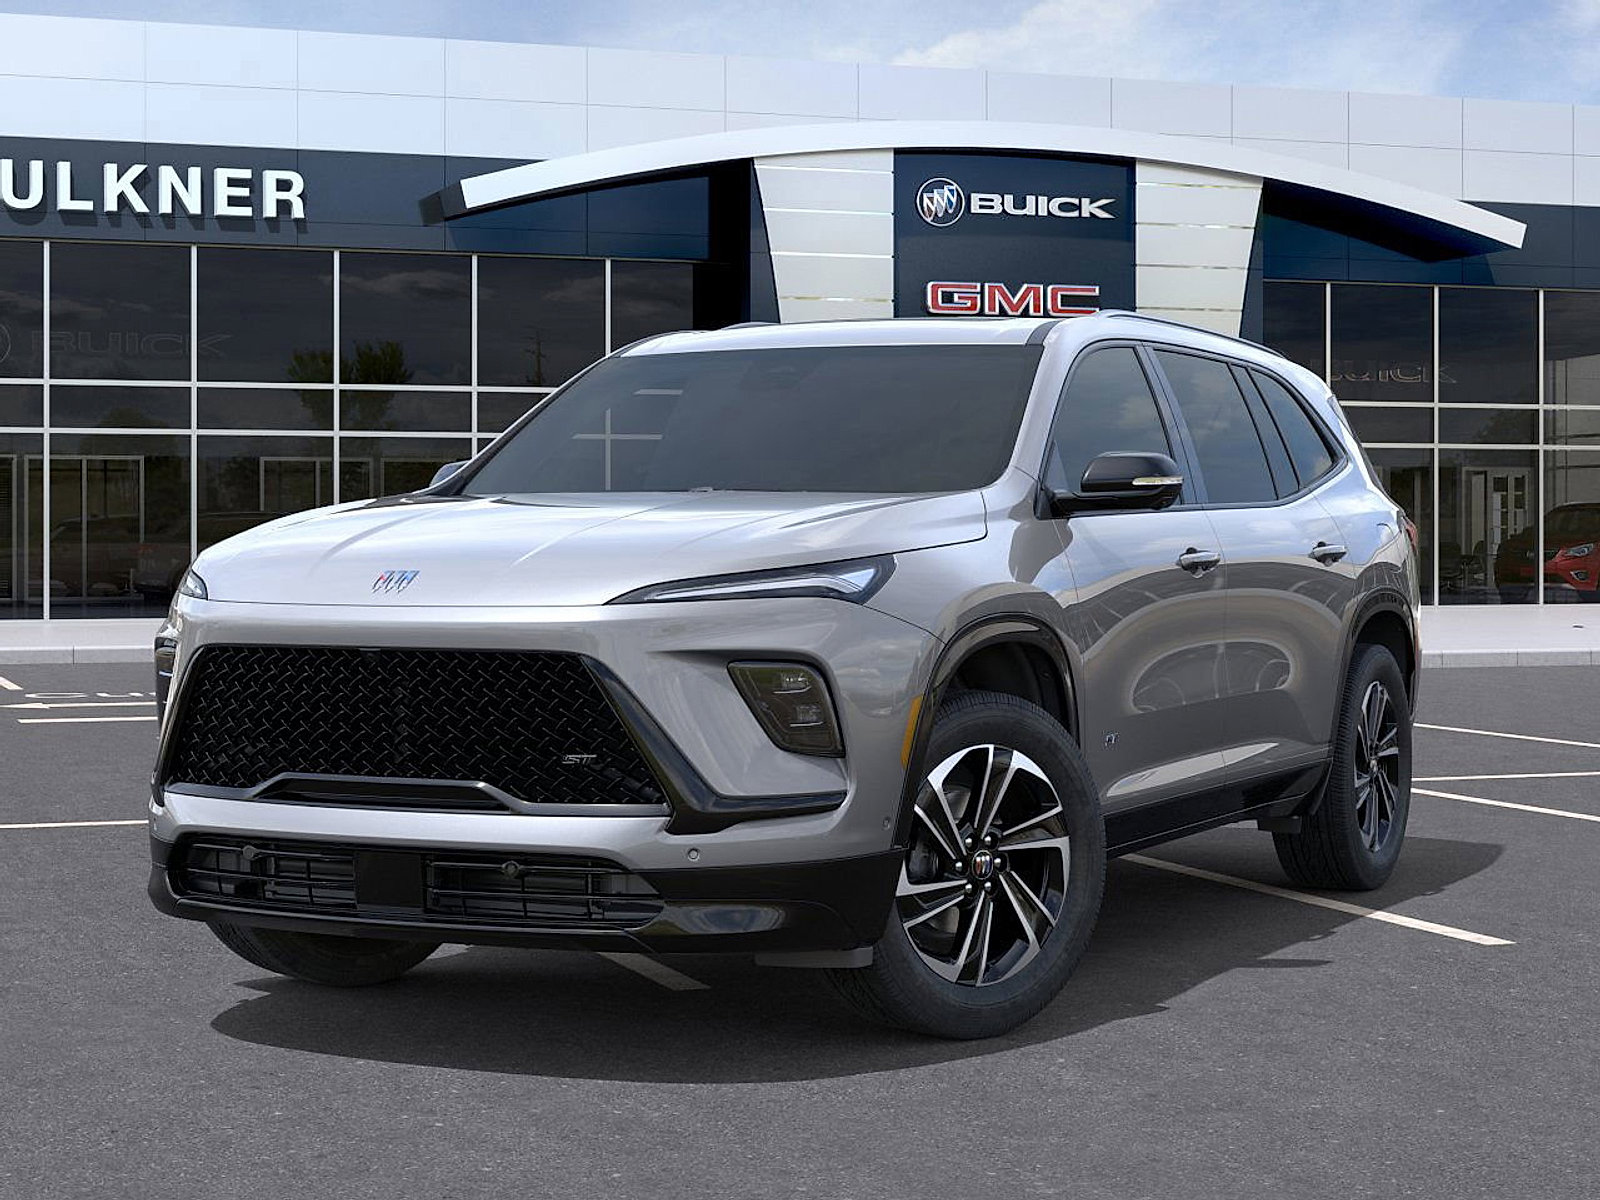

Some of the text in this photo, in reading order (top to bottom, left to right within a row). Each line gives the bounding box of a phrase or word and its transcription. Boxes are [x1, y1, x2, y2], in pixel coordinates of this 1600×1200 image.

[0, 159, 305, 219] ULKNER
[970, 193, 1116, 219] BUICK
[927, 281, 1100, 317] GMC
